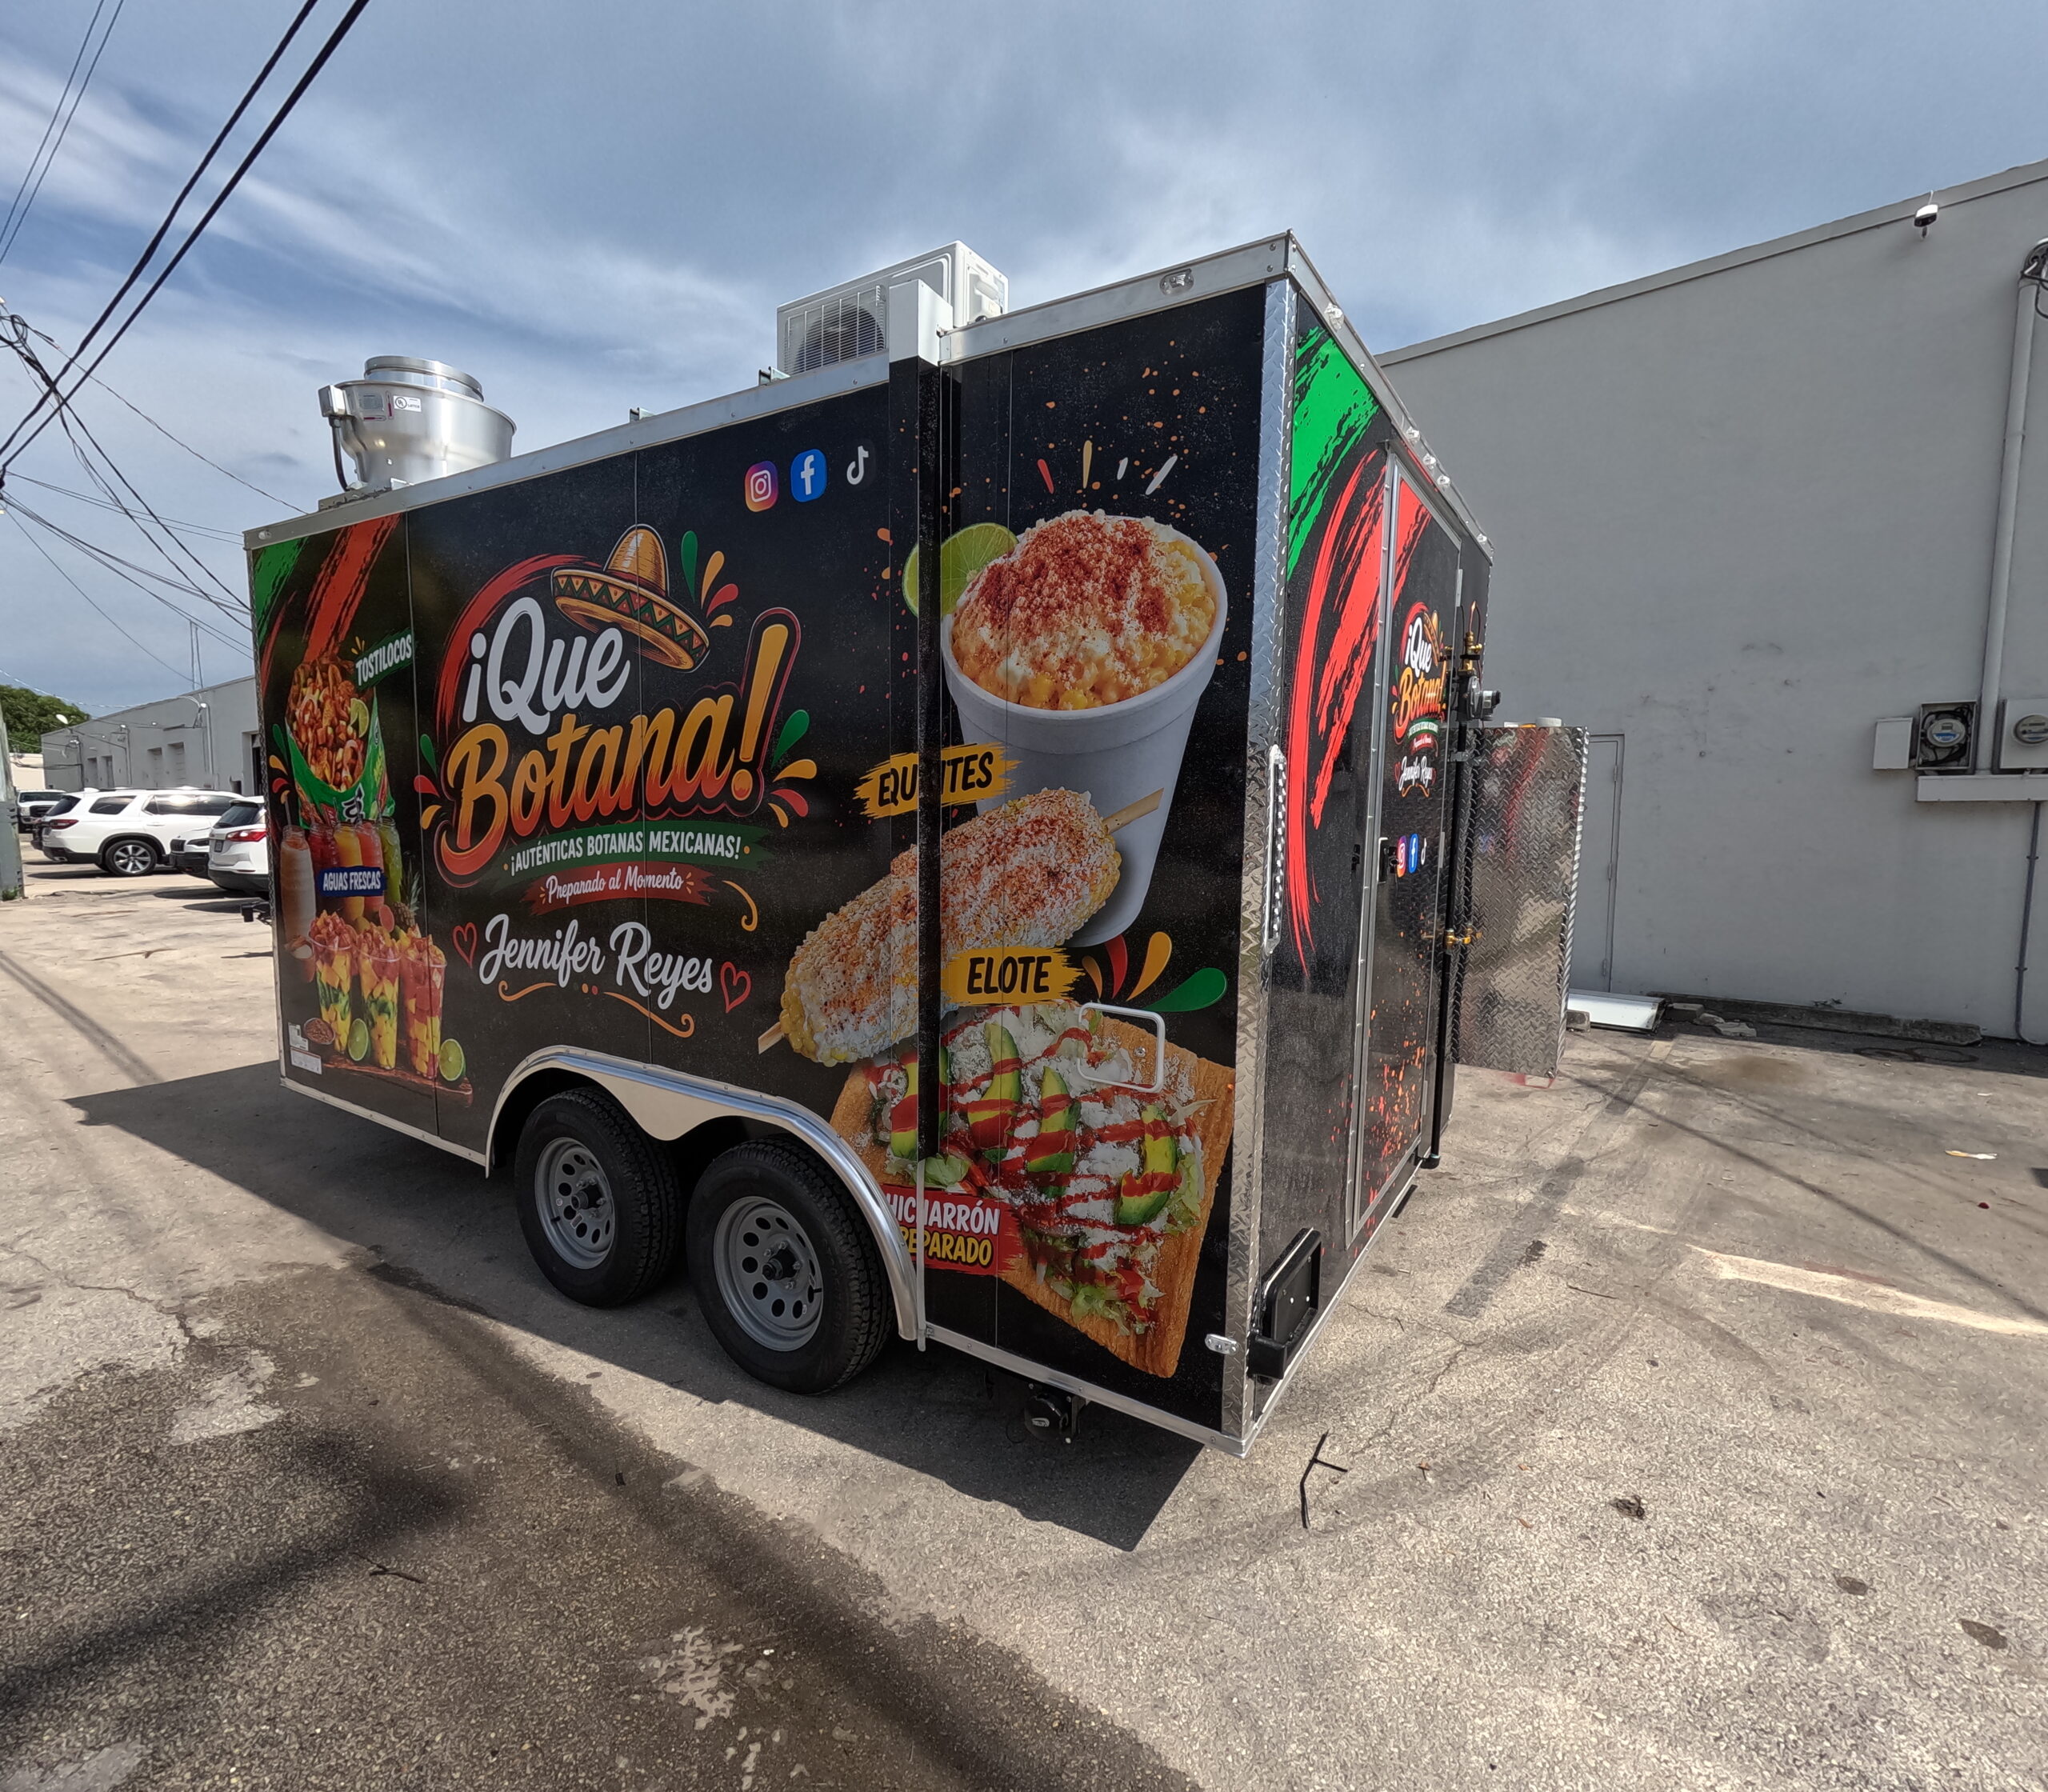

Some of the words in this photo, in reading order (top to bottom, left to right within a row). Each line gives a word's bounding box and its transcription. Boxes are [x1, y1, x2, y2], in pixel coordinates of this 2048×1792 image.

[355, 634, 412, 686] TOSTILOCOS
[462, 597, 630, 735] ¡Que
[441, 623, 789, 875] Botana!
[510, 836, 583, 876] ¡AUTÉNTICAS
[586, 830, 643, 857] BOTANAS
[649, 830, 741, 860] MEXICANAS!
[323, 872, 348, 891] AGUAS
[350, 870, 382, 890] FRESCAS
[546, 870, 606, 905] Preparado
[608, 867, 622, 890] al
[624, 865, 685, 891] Momento
[479, 914, 606, 988] Jennifer
[610, 921, 713, 1010] Reyes
[966, 955, 1052, 995] ELOTE
